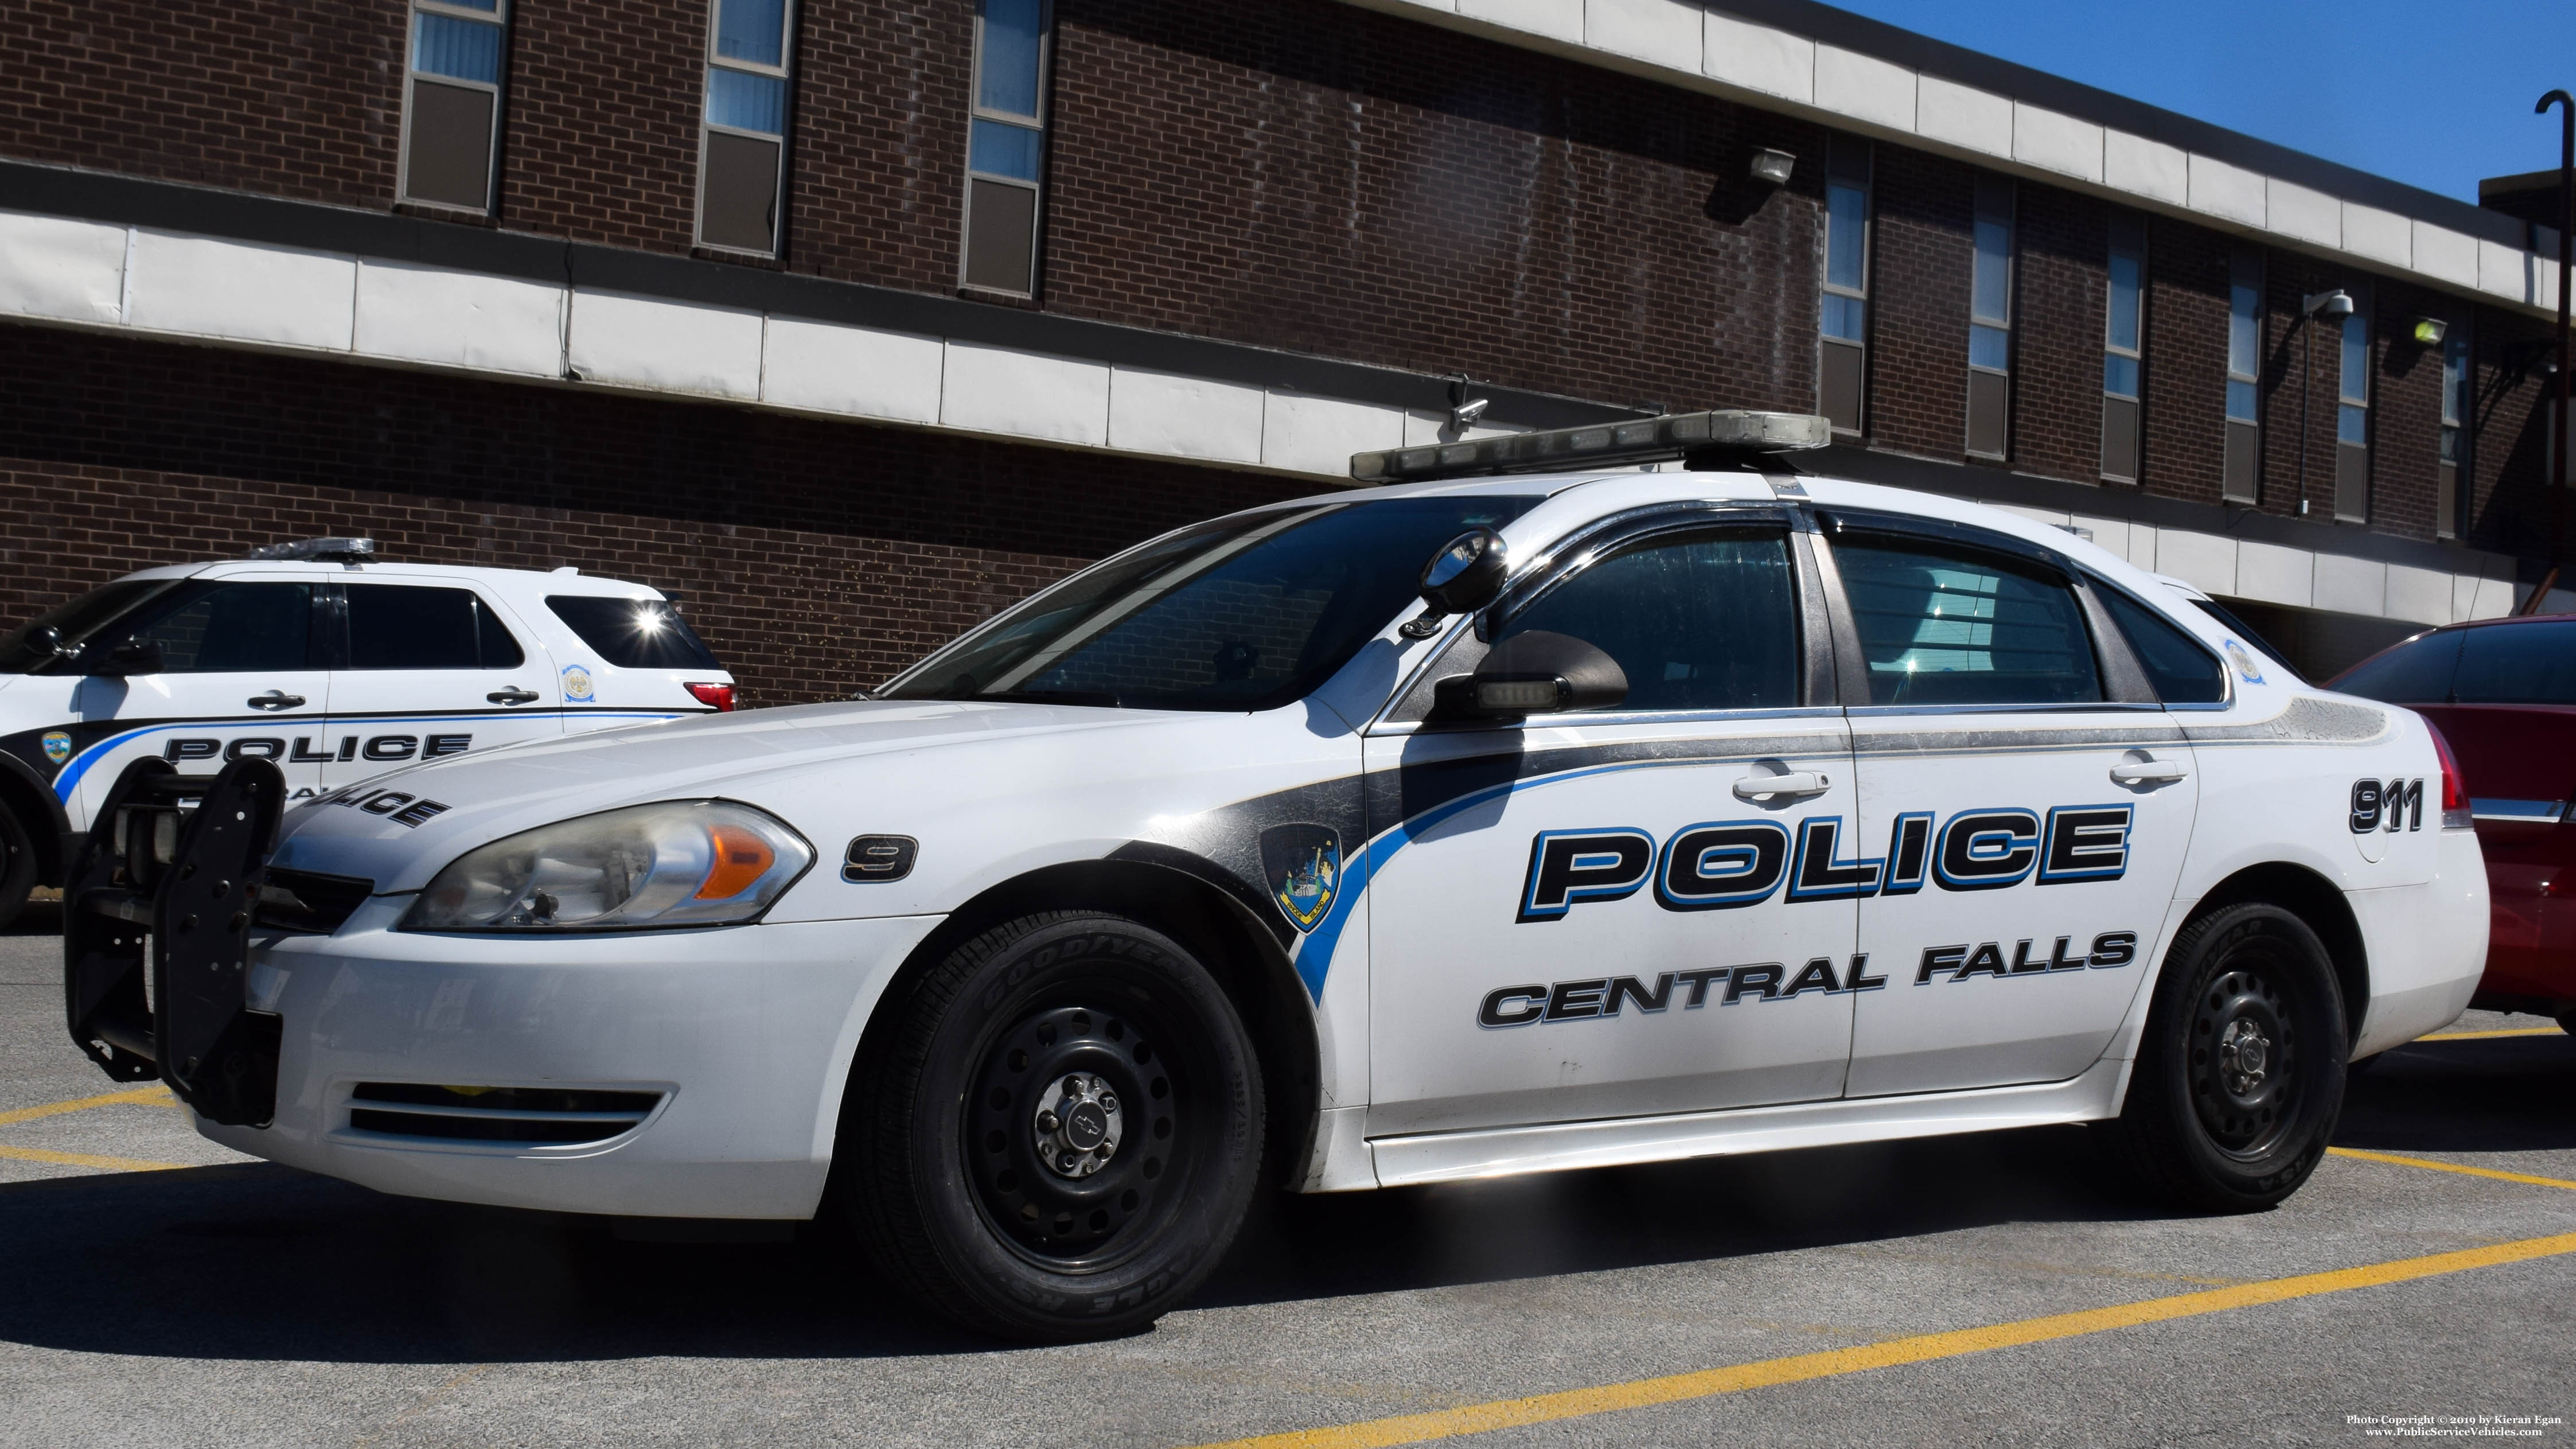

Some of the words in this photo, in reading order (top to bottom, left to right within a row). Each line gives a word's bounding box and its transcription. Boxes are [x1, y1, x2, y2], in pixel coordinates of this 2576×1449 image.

[163, 733, 473, 765] POLICE
[304, 786, 454, 828] LICE
[2349, 777, 2424, 834] 911
[840, 833, 919, 884] 9
[1515, 803, 2135, 924] POLICE
[1287, 901, 1303, 919] RHODE
[1310, 900, 1325, 919] ISLAND
[1476, 953, 1888, 1032] CENTRAL
[1914, 930, 2138, 987] FALLS
